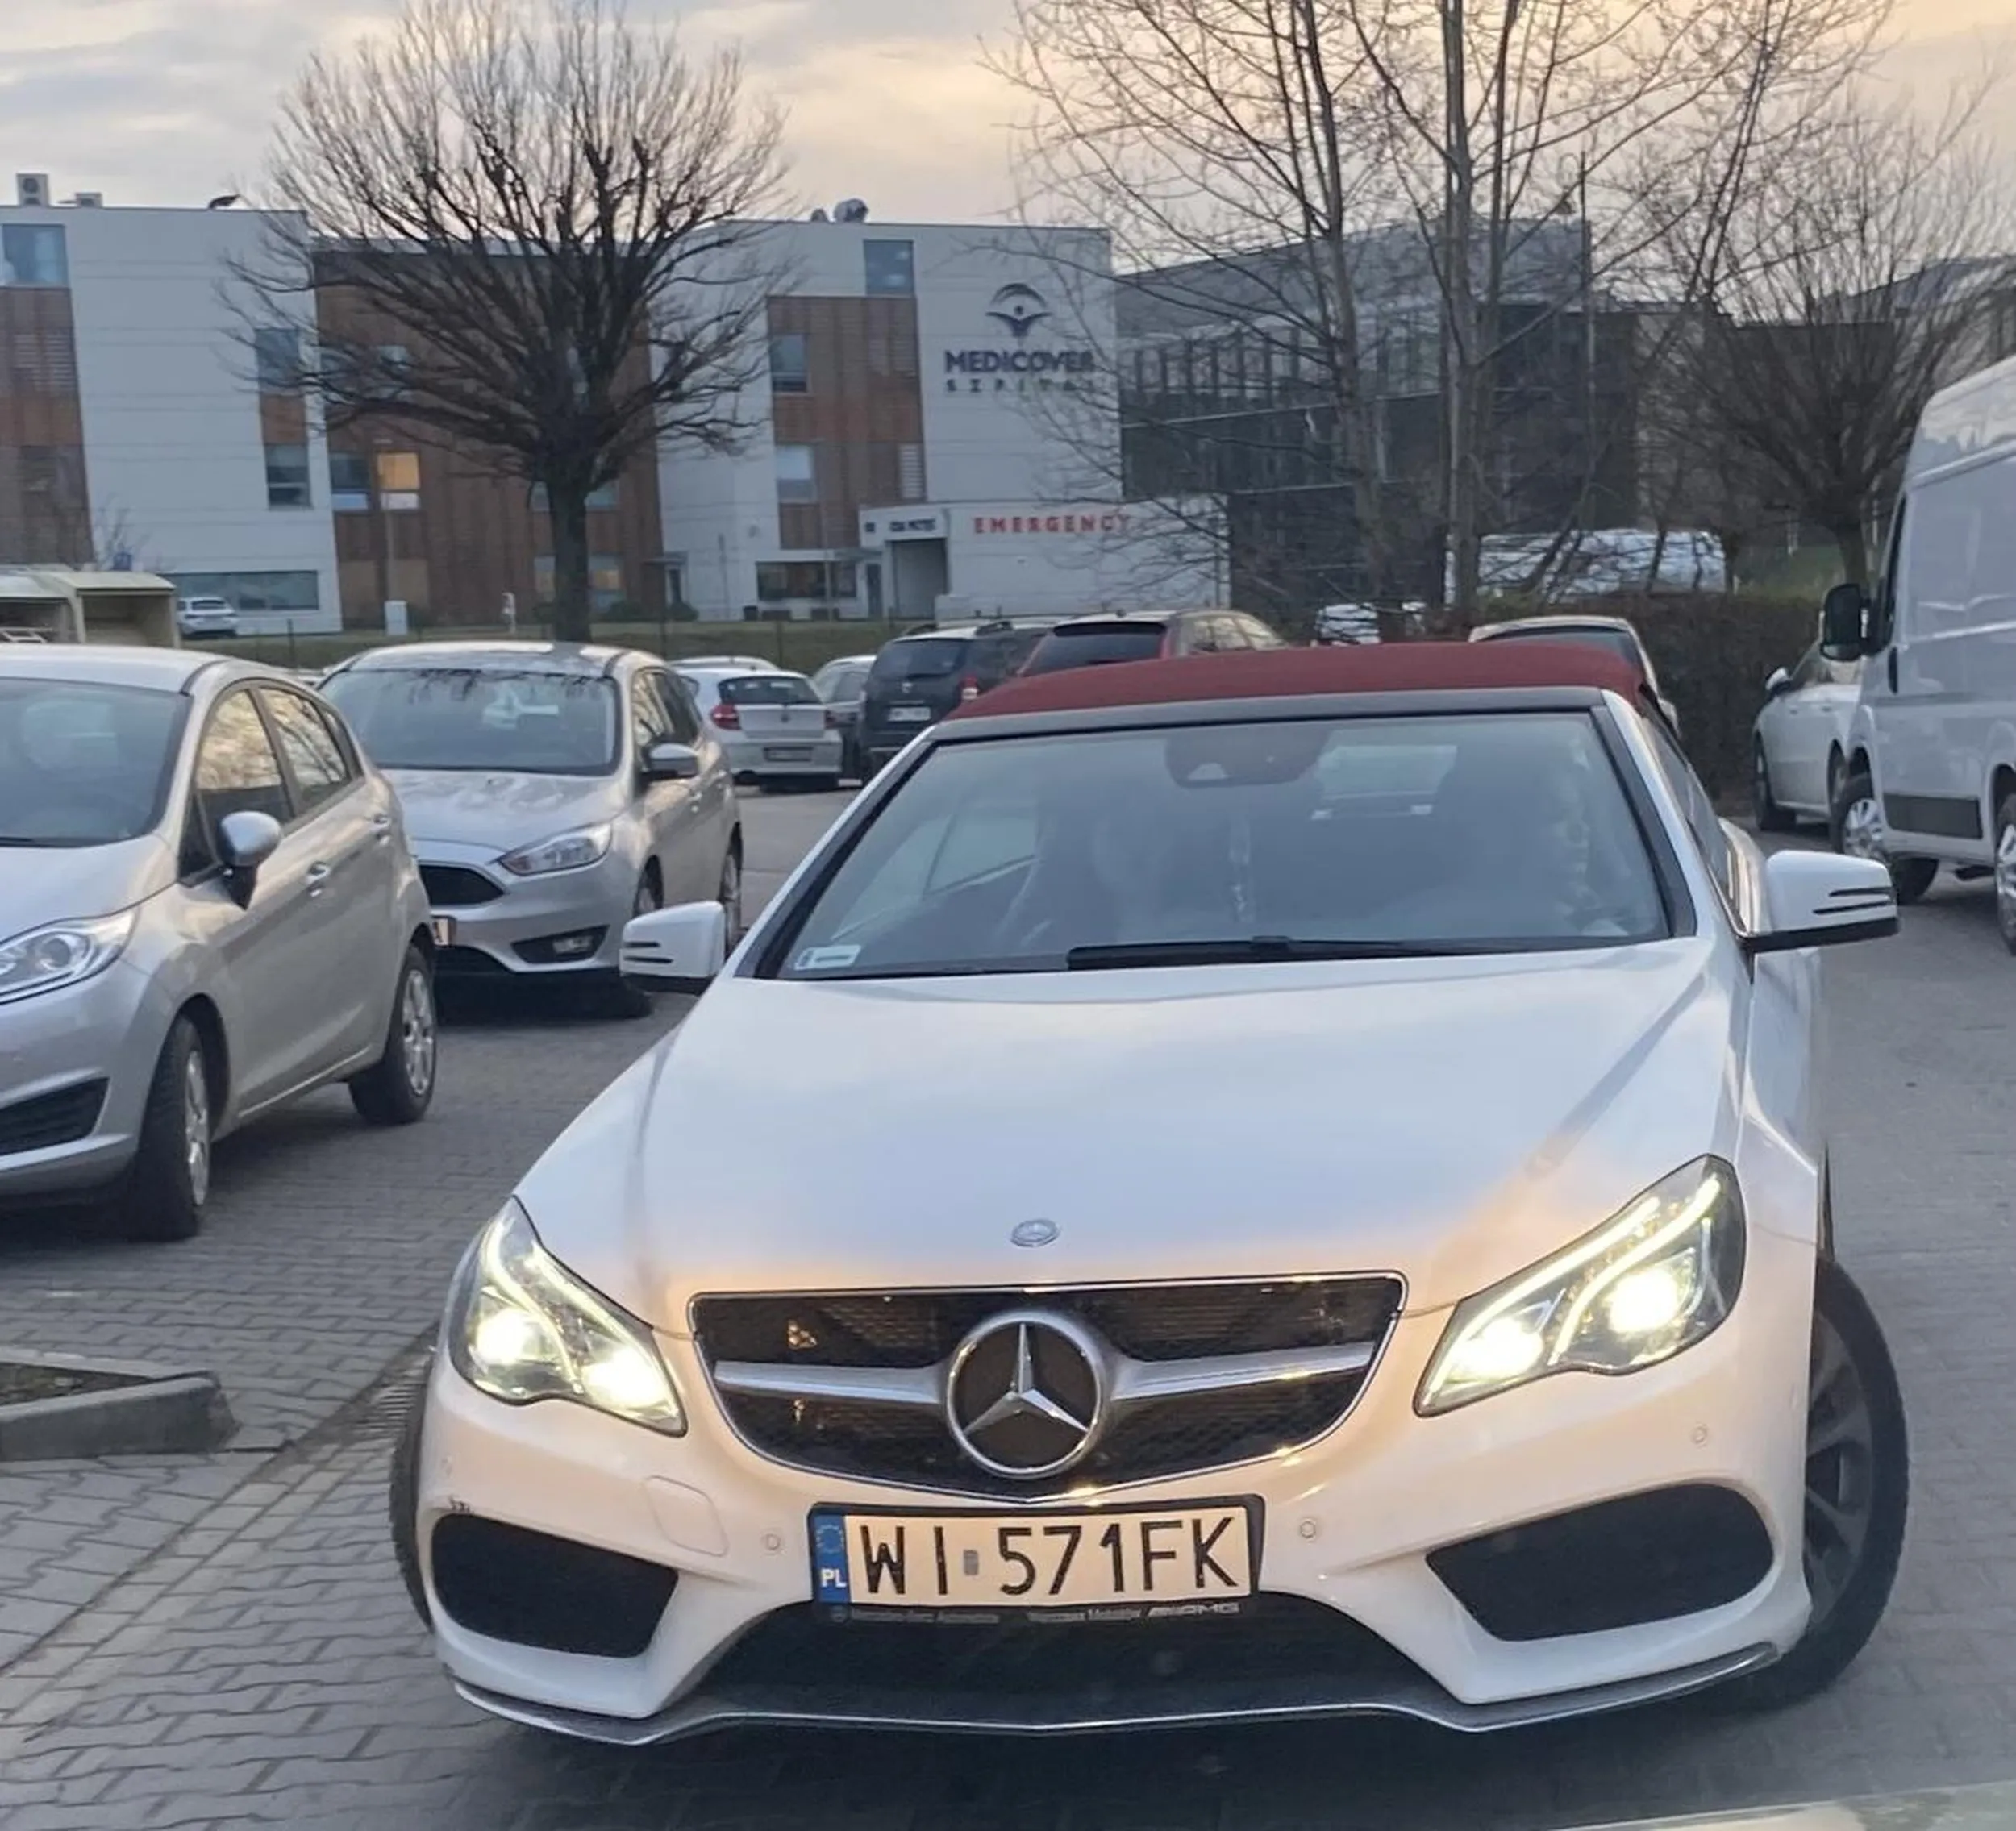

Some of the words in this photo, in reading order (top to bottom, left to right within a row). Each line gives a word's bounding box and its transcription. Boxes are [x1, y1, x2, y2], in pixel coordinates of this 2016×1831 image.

[944, 350, 1095, 372] MEDICOVER
[973, 514, 1130, 534] EMERGENCY
[860, 1524, 948, 1596] WI
[997, 1517, 1239, 1596] 571FK
[820, 1569, 848, 1588] PL
